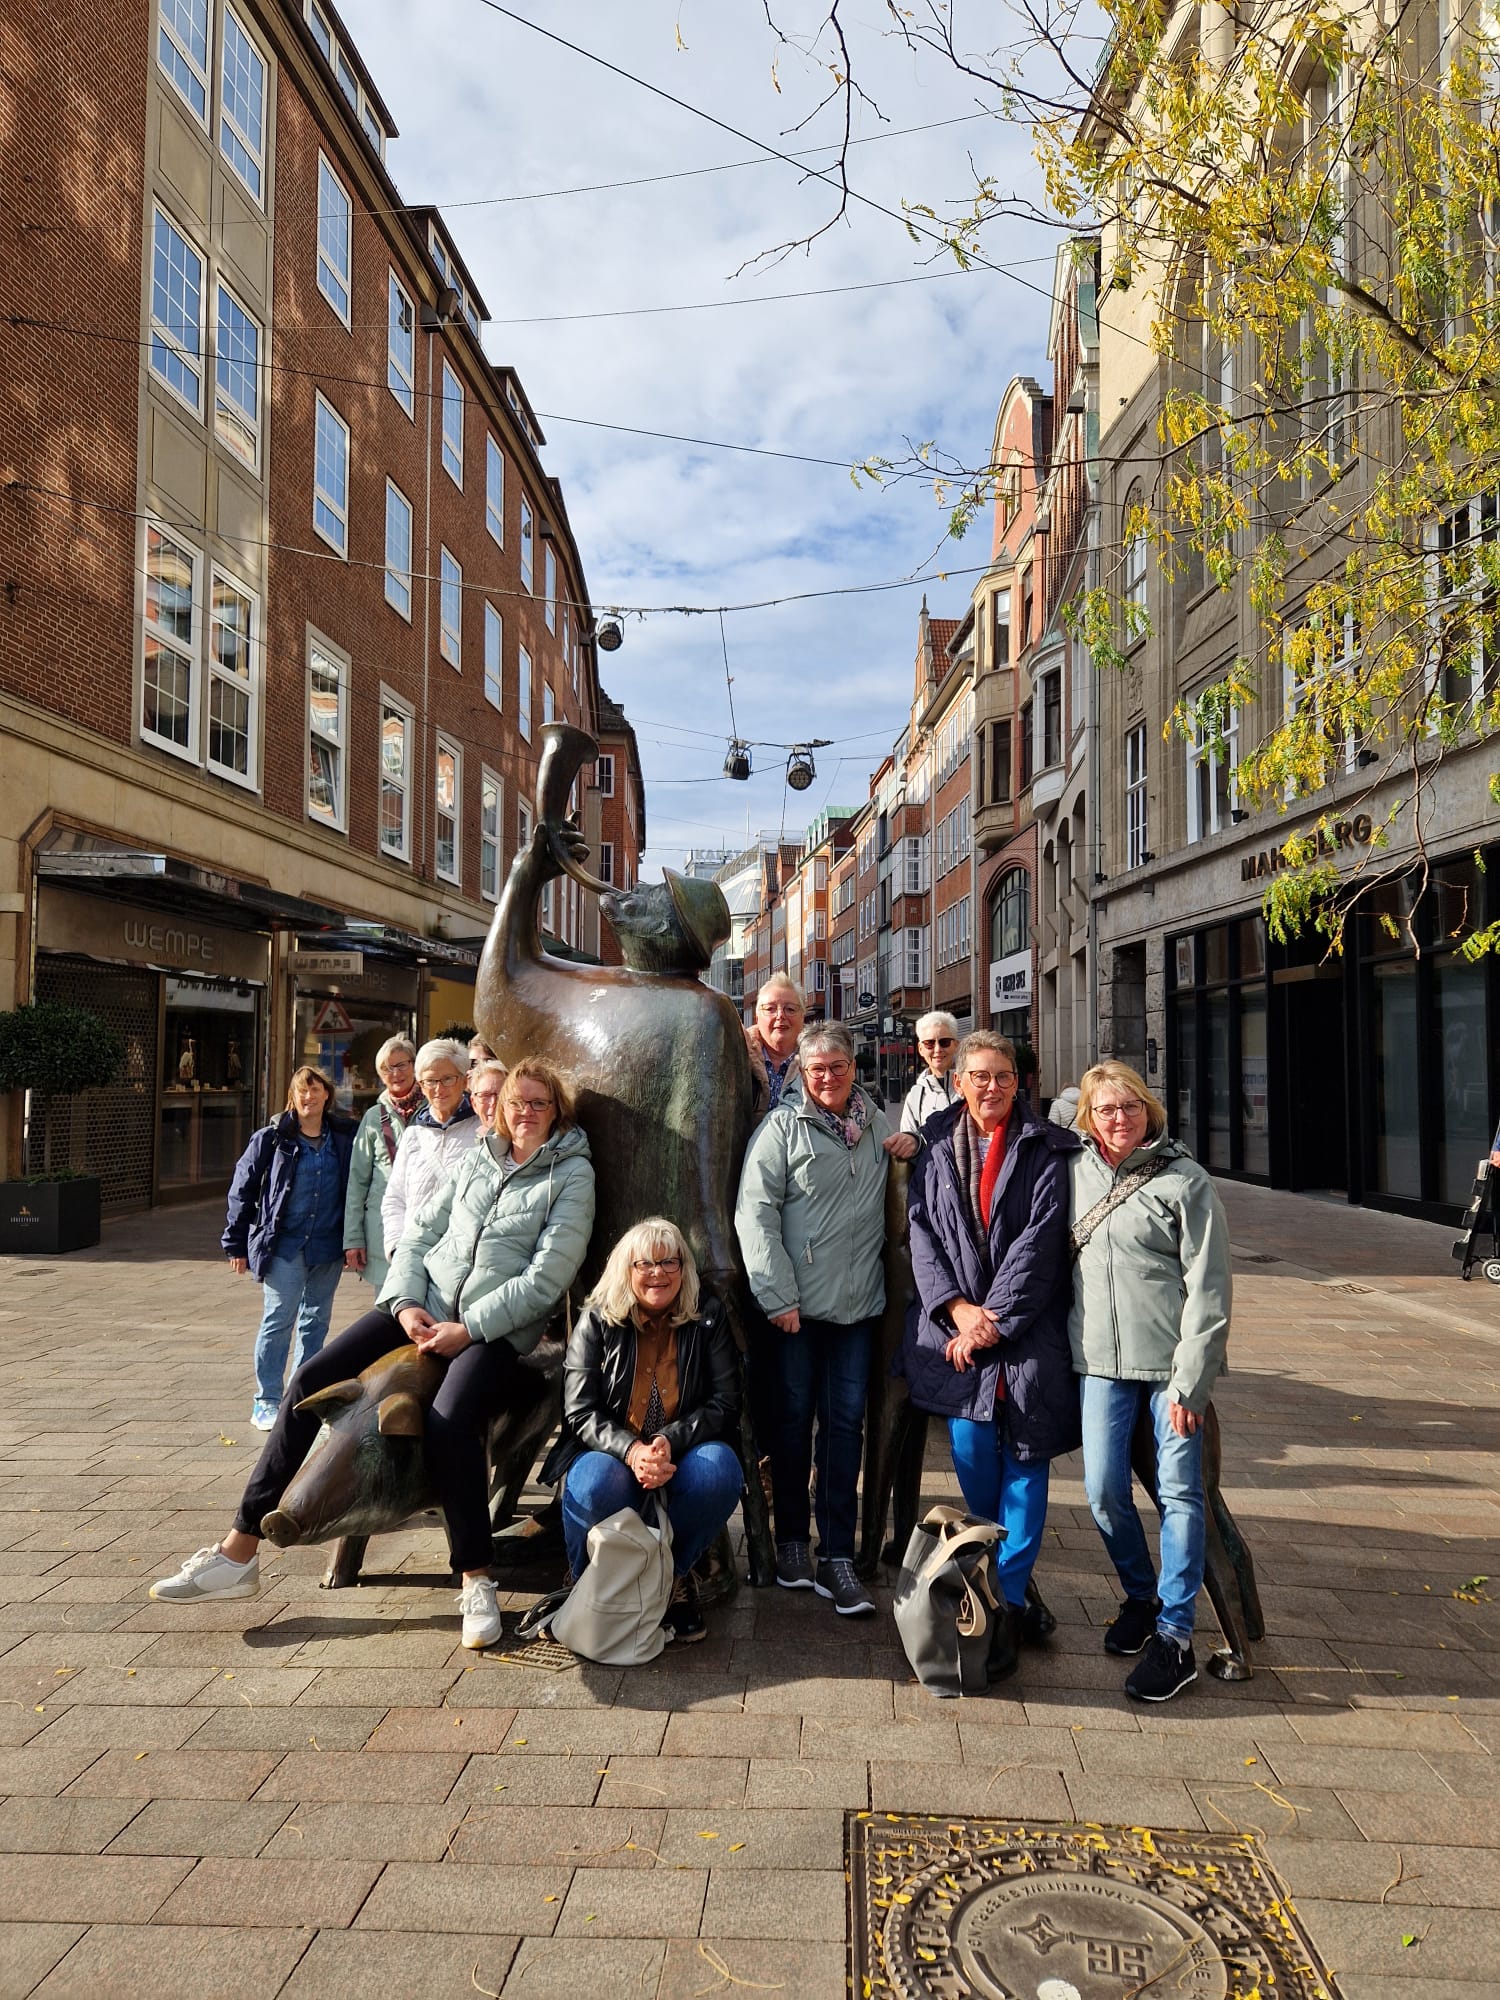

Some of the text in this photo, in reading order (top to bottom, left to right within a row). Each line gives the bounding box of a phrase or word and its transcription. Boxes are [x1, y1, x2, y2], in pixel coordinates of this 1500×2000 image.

[1240, 813, 1373, 881] MAHBERG
[124, 921, 214, 960] WEMPE
[295, 958, 351, 969] WEMPE
